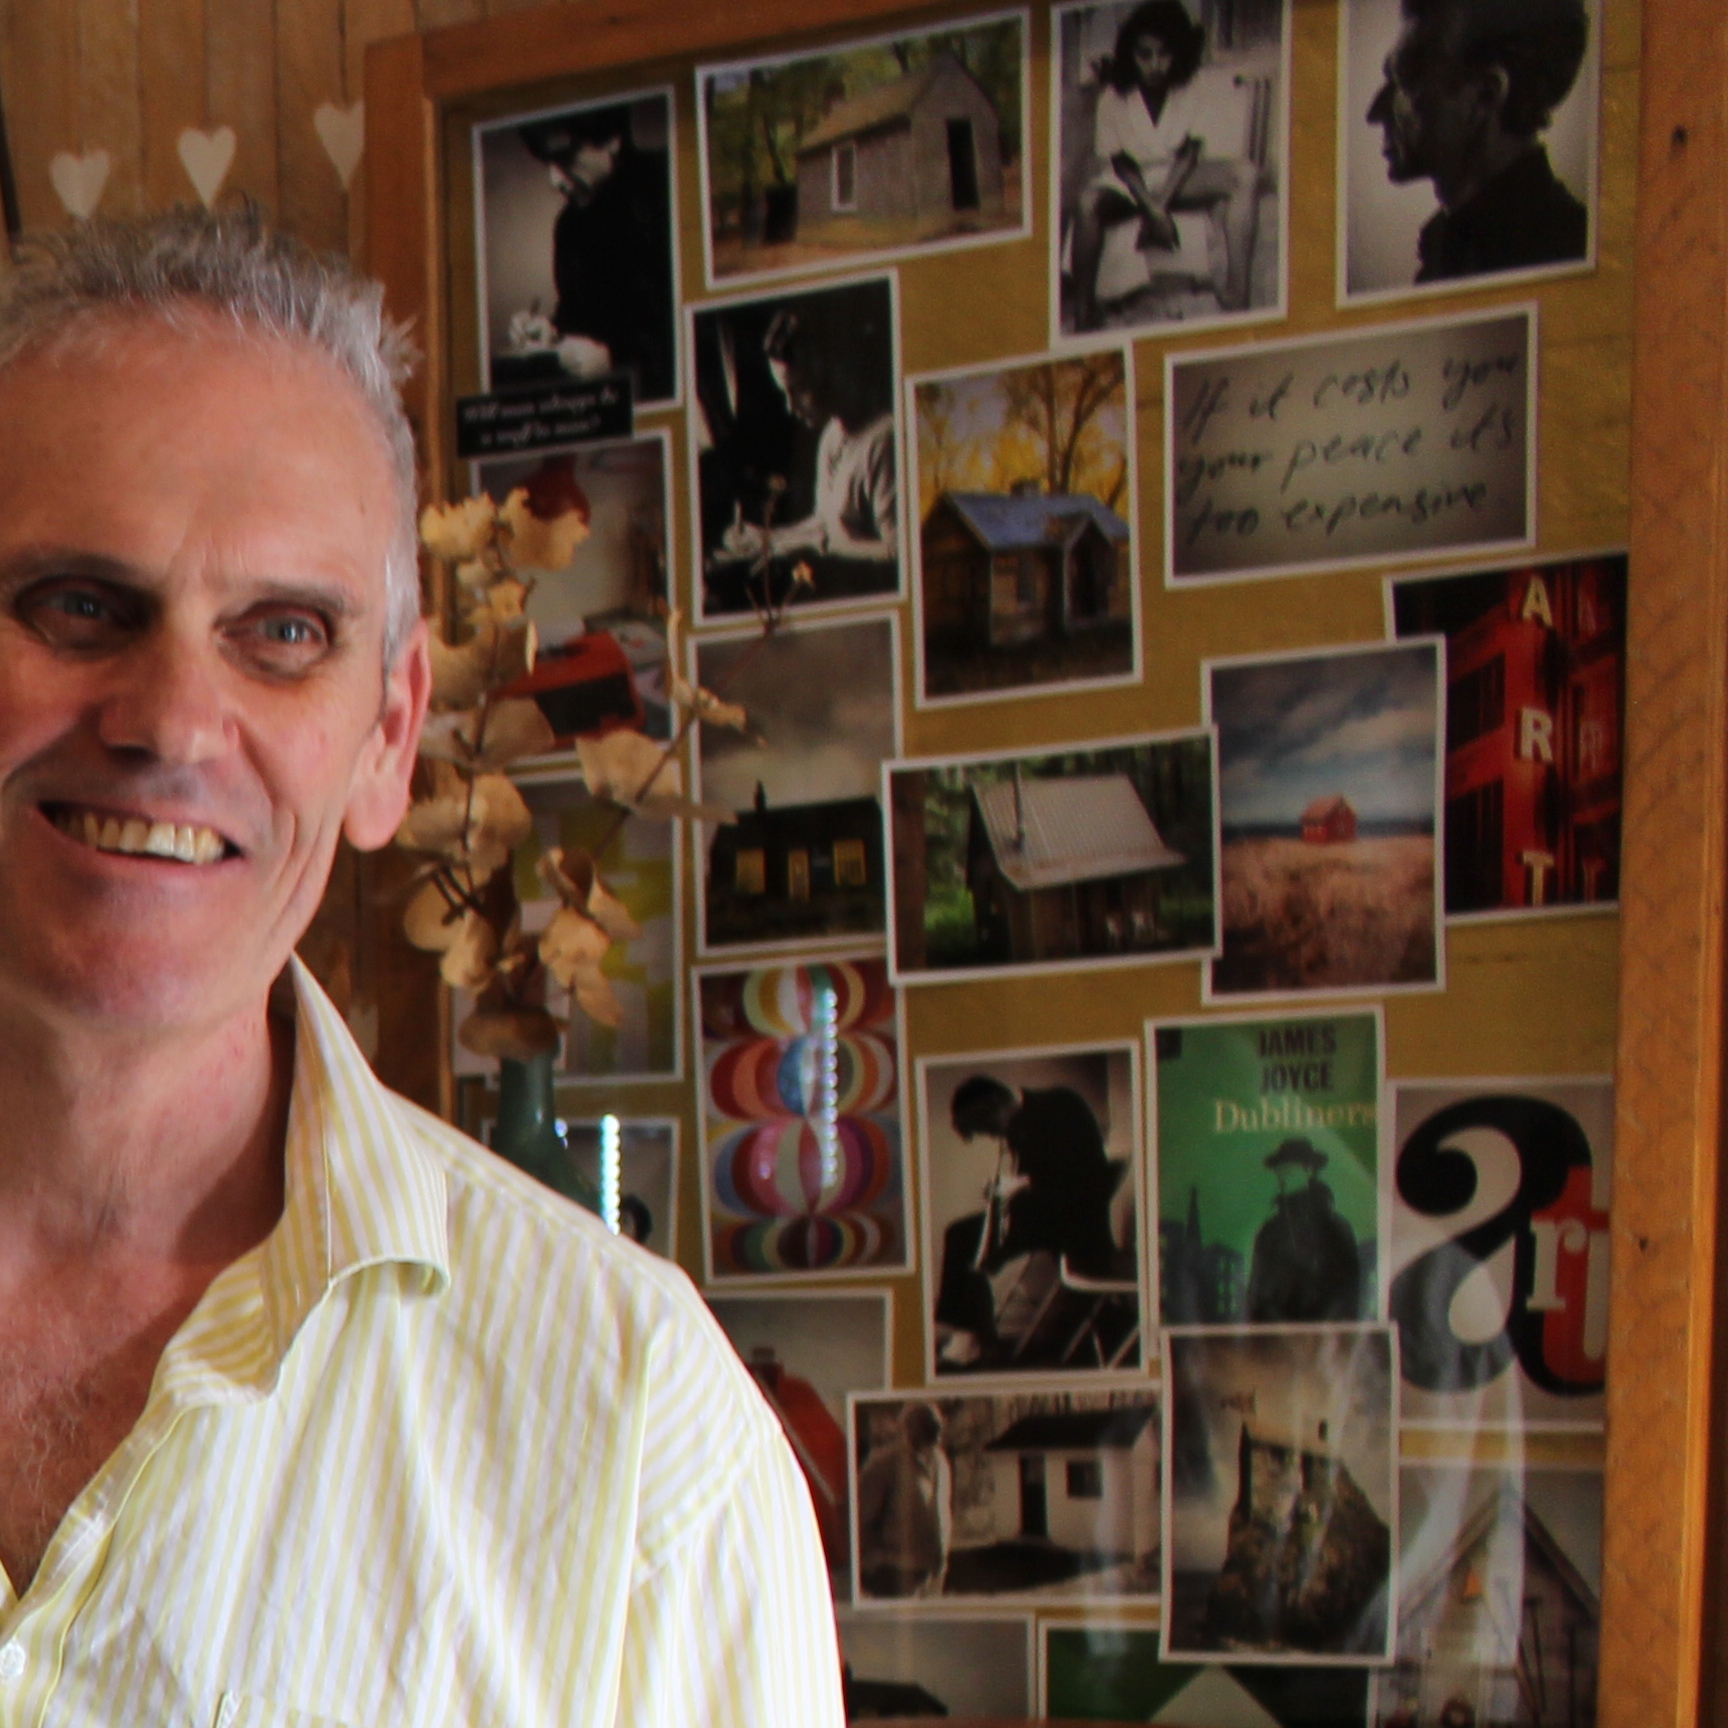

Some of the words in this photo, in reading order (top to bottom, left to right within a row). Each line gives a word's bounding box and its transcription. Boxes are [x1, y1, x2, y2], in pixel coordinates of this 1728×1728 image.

[1280, 425, 1423, 496] peace
[1185, 497, 1260, 547] too
[1520, 573, 1556, 907] ART
[1258, 1025, 1338, 1058] JAMES
[1258, 1060, 1334, 1096] JOYCE
